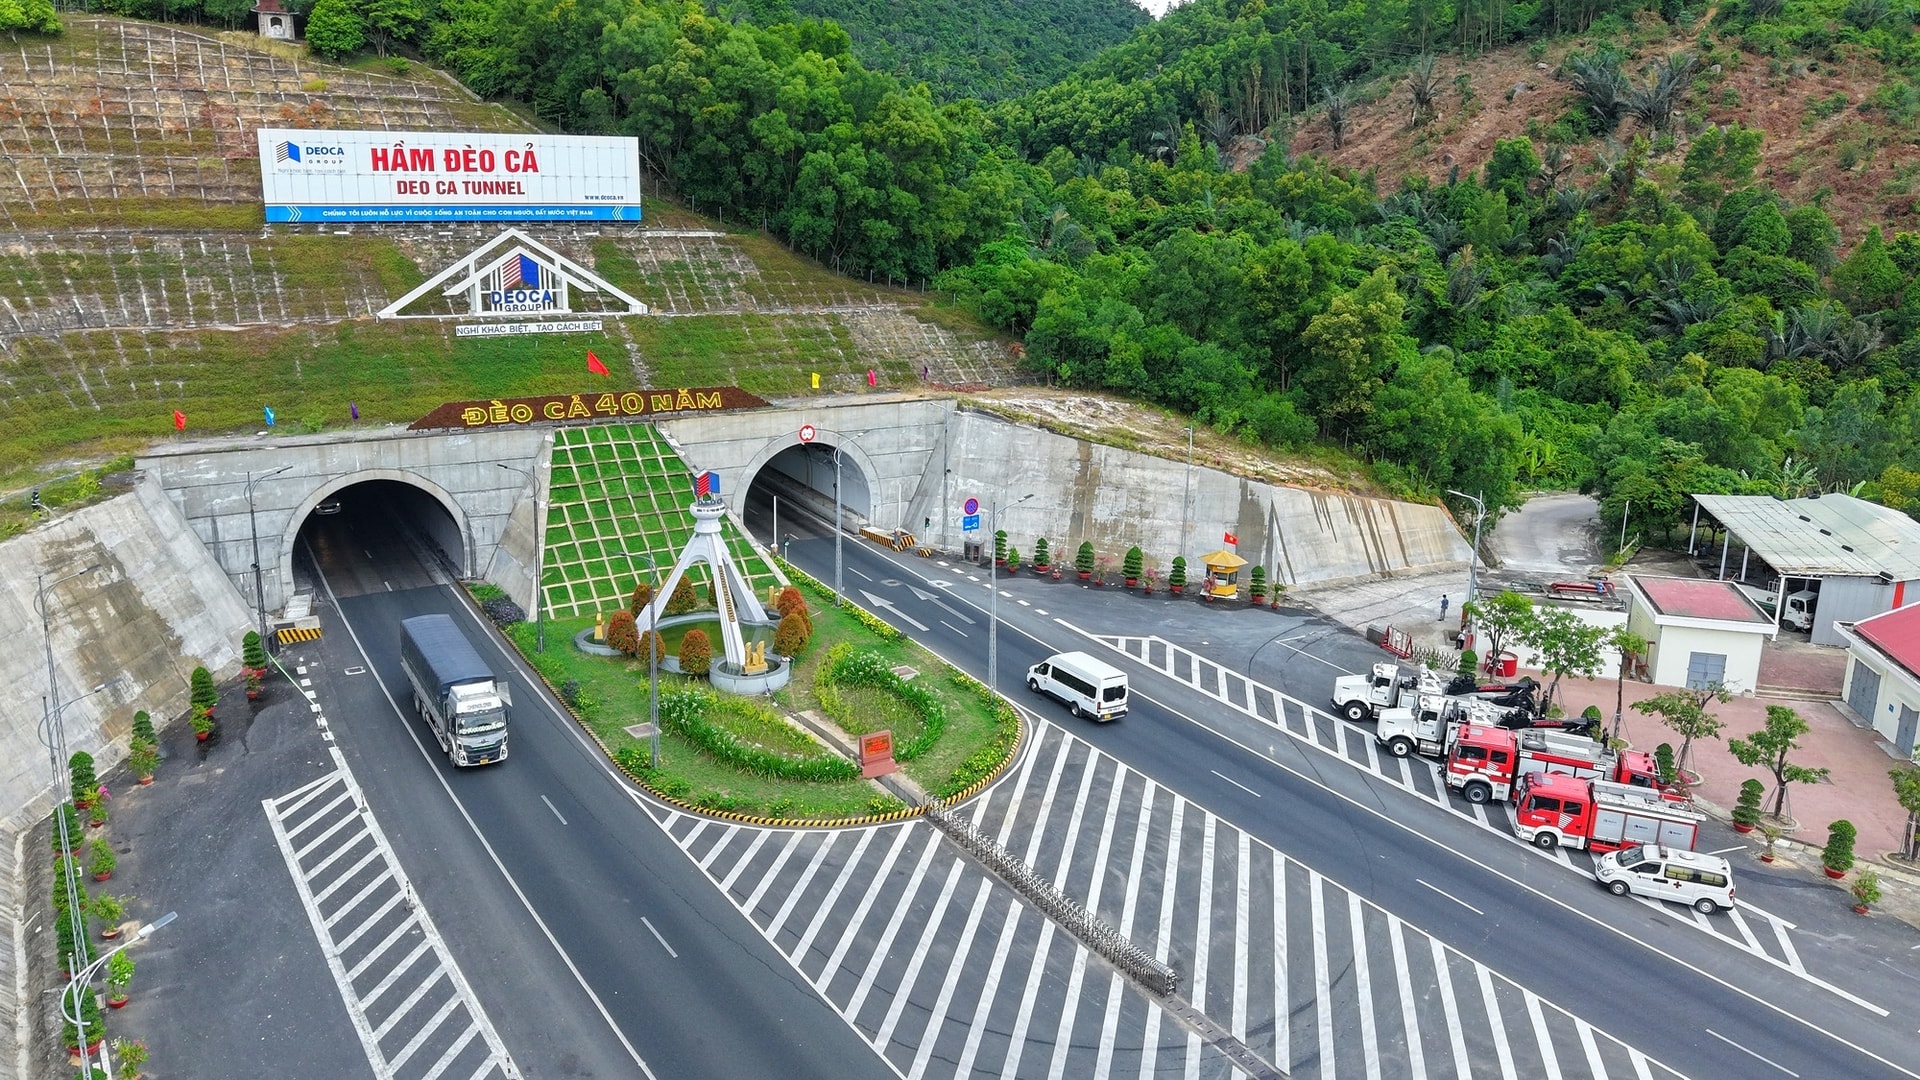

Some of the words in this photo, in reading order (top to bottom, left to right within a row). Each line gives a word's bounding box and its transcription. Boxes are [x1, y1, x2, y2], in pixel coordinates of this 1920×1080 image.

[306, 146, 345, 156] DEOCA
[371, 140, 435, 172] HẦM
[444, 144, 495, 172] ĐÈO
[504, 142, 539, 173] CẢ
[397, 181, 430, 194] DEO
[436, 181, 458, 194] CA
[462, 181, 525, 194] TUNNEL
[491, 290, 553, 304] DEOCA
[504, 304, 542, 312] GROUP
[482, 324, 506, 334] KHÁC
[556, 322, 580, 331] CÁCH
[461, 400, 533, 426] ĐÈO
[544, 395, 590, 420] CẢ
[596, 393, 644, 415] 40
[651, 388, 722, 412] NĂM
